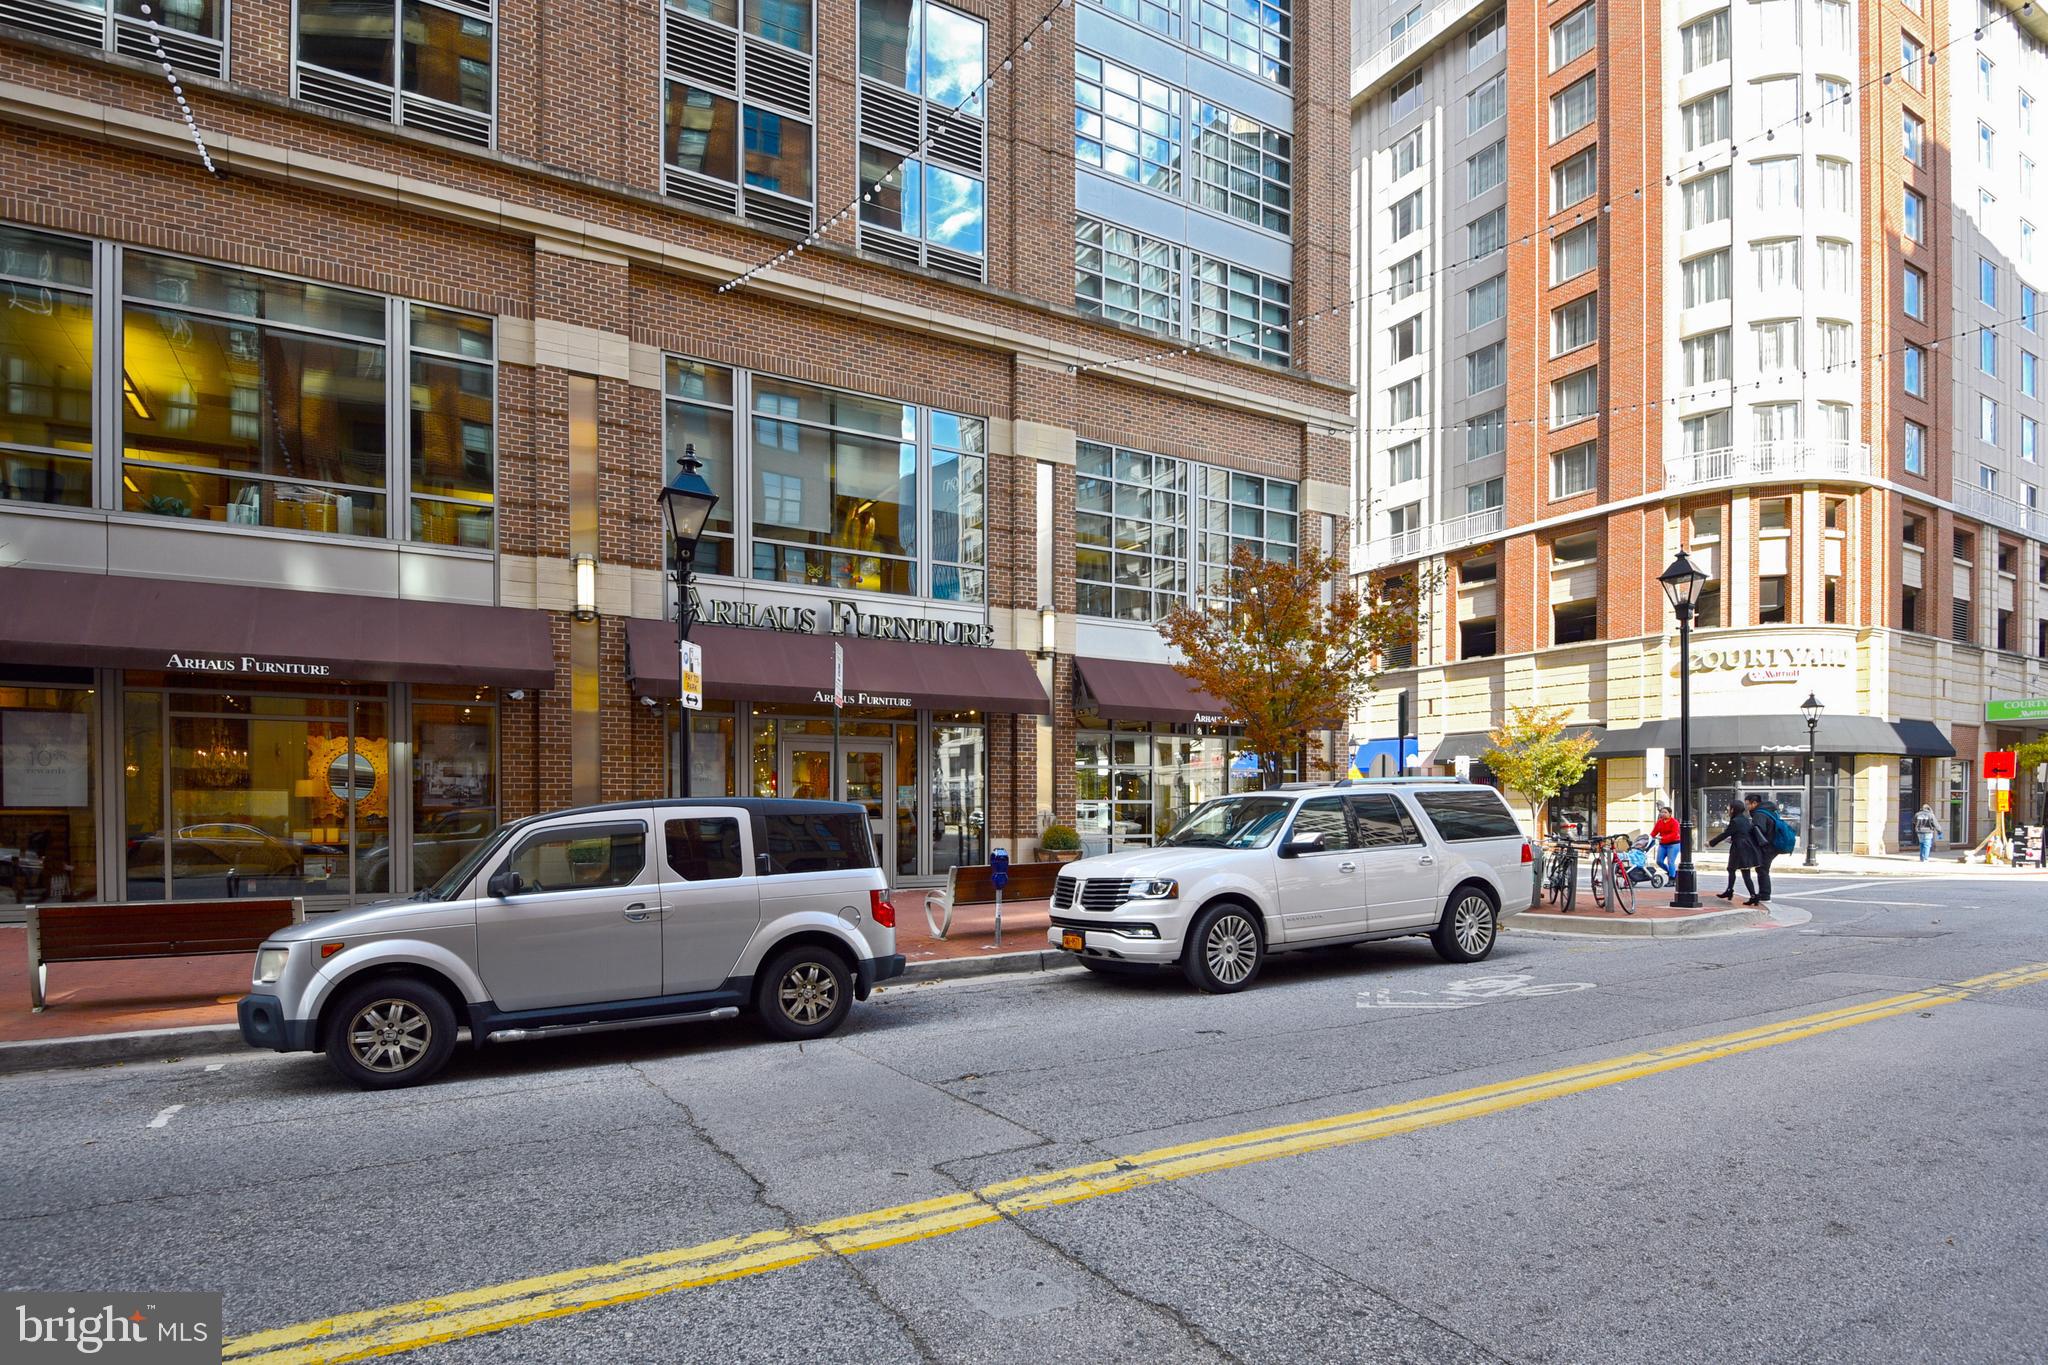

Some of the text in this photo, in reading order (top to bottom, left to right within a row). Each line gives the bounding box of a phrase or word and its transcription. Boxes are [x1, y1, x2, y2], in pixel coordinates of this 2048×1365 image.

[672, 586, 995, 647] ARHAUS FURNITURE
[166, 654, 329, 675] ARHAUS FURNITURE
[813, 690, 912, 706] ARHUS FURNITURE
